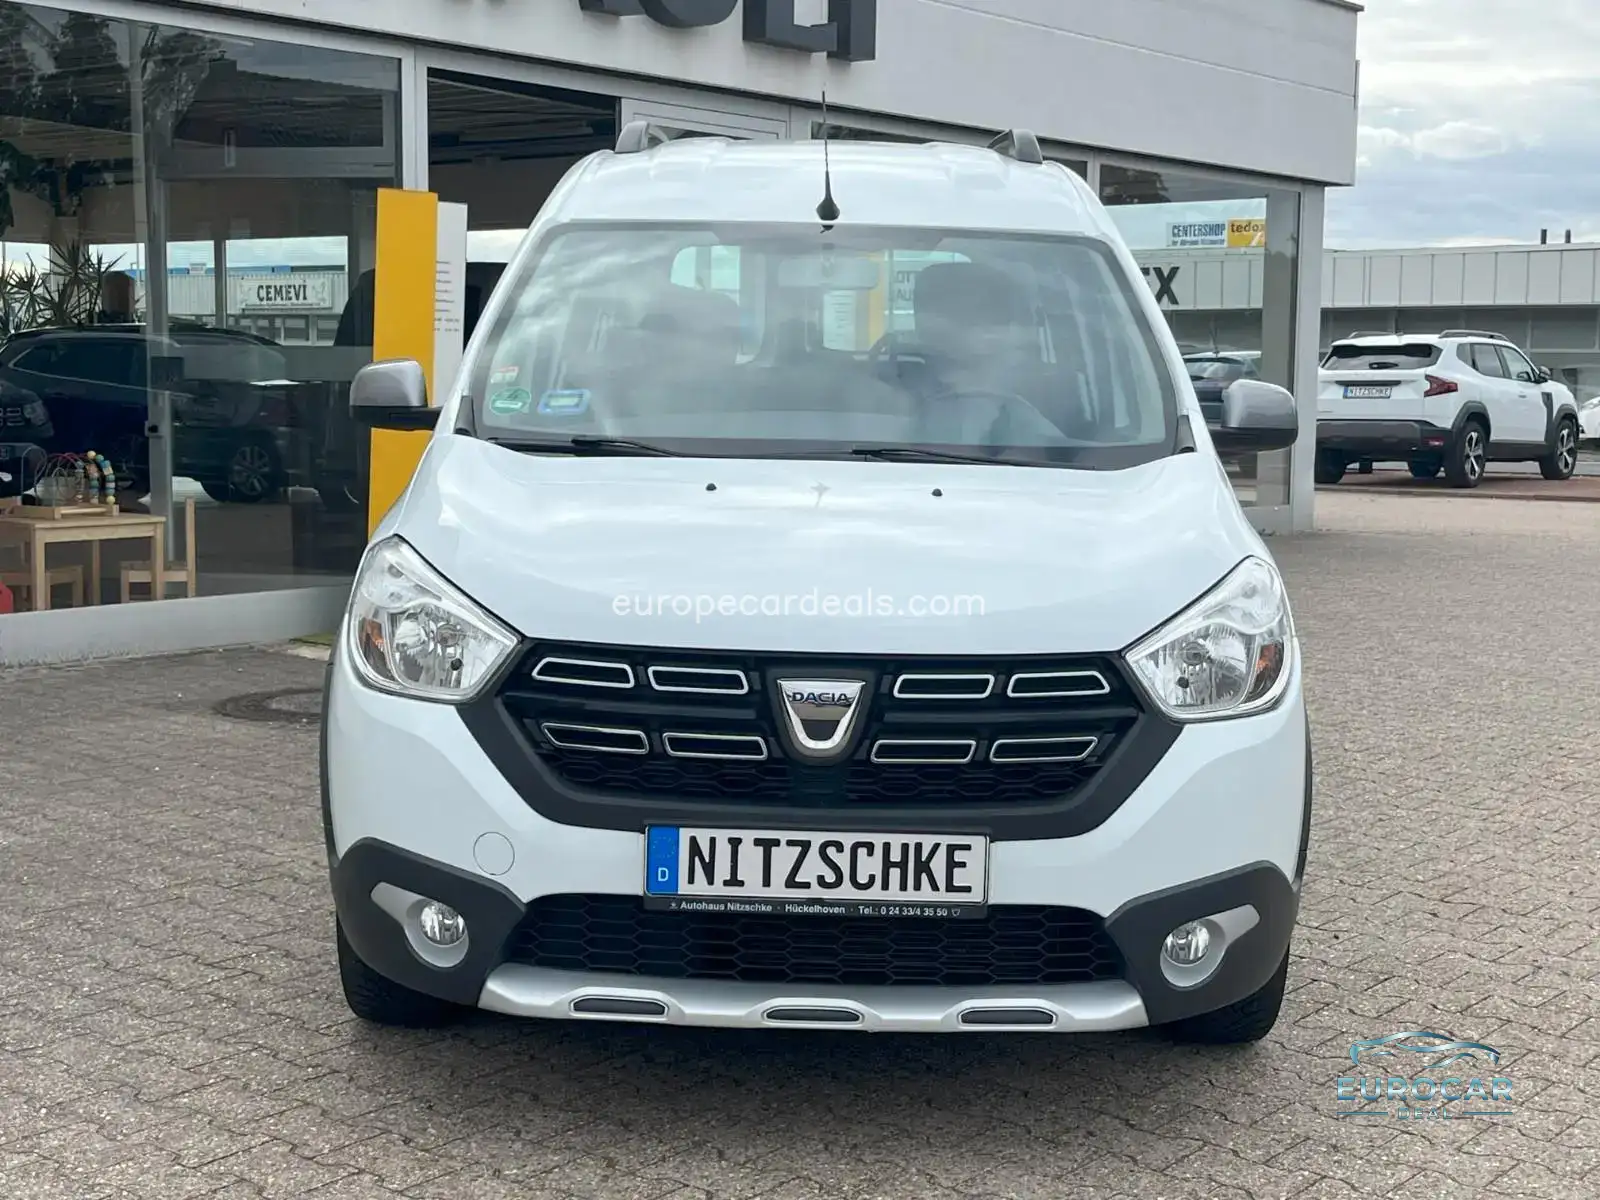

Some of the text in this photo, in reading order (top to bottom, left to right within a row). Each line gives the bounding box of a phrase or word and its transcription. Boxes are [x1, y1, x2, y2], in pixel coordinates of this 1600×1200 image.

[1171, 223, 1226, 238] CENTERSHOP
[1140, 266, 1180, 305] X
[791, 692, 848, 702] DACIA
[658, 835, 973, 893] D NITZSCHKE
[680, 901, 725, 911] Autohaus
[727, 902, 772, 912] Nitzschke
[785, 903, 845, 914] Hückelhoven
[888, 906, 899, 915] 24
[923, 907, 934, 916] 35
